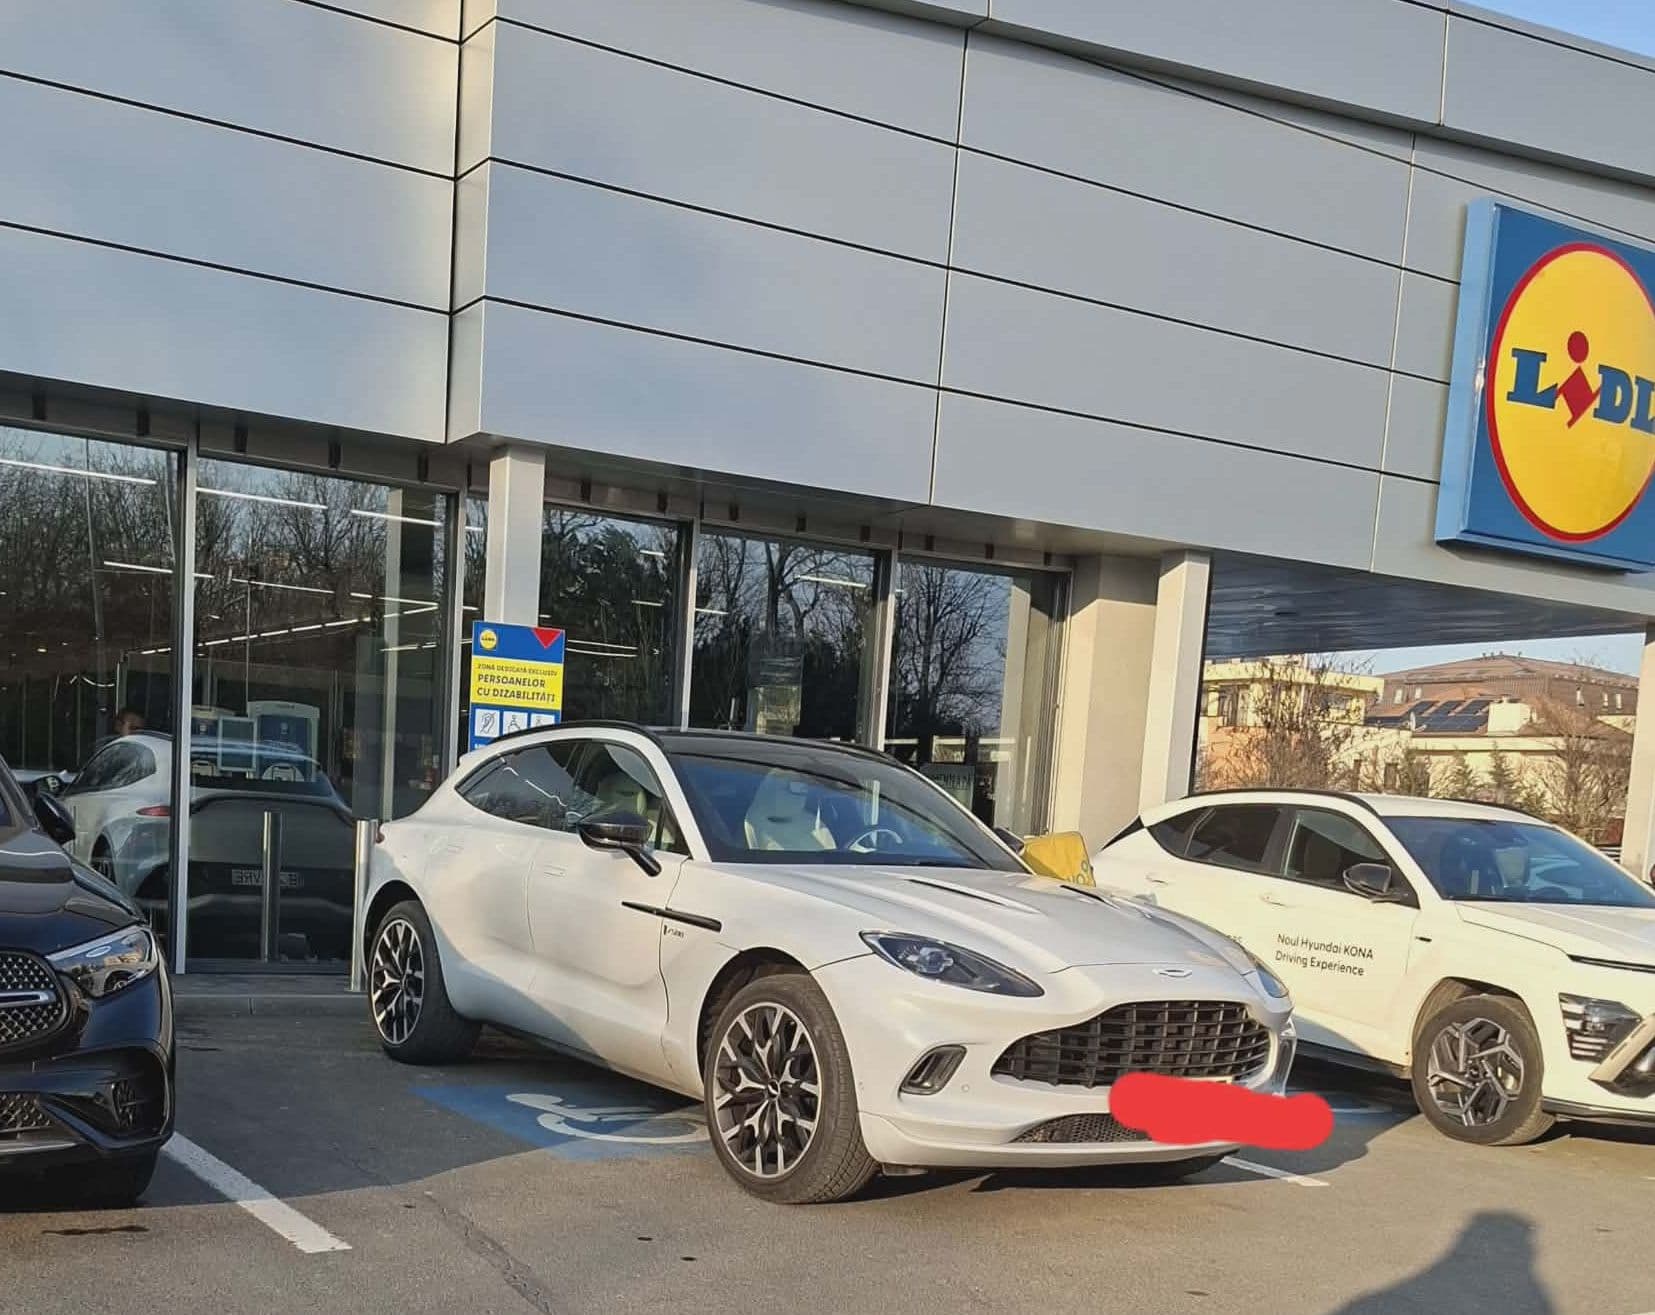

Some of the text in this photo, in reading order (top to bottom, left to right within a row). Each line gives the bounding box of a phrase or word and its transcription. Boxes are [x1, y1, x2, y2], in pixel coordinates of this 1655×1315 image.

[478, 674, 545, 688] PERSOANELOR
[477, 687, 490, 696] CU
[1277, 933, 1374, 959] Noul Hyundai KONA
[1275, 950, 1364, 976] Driving Experience
